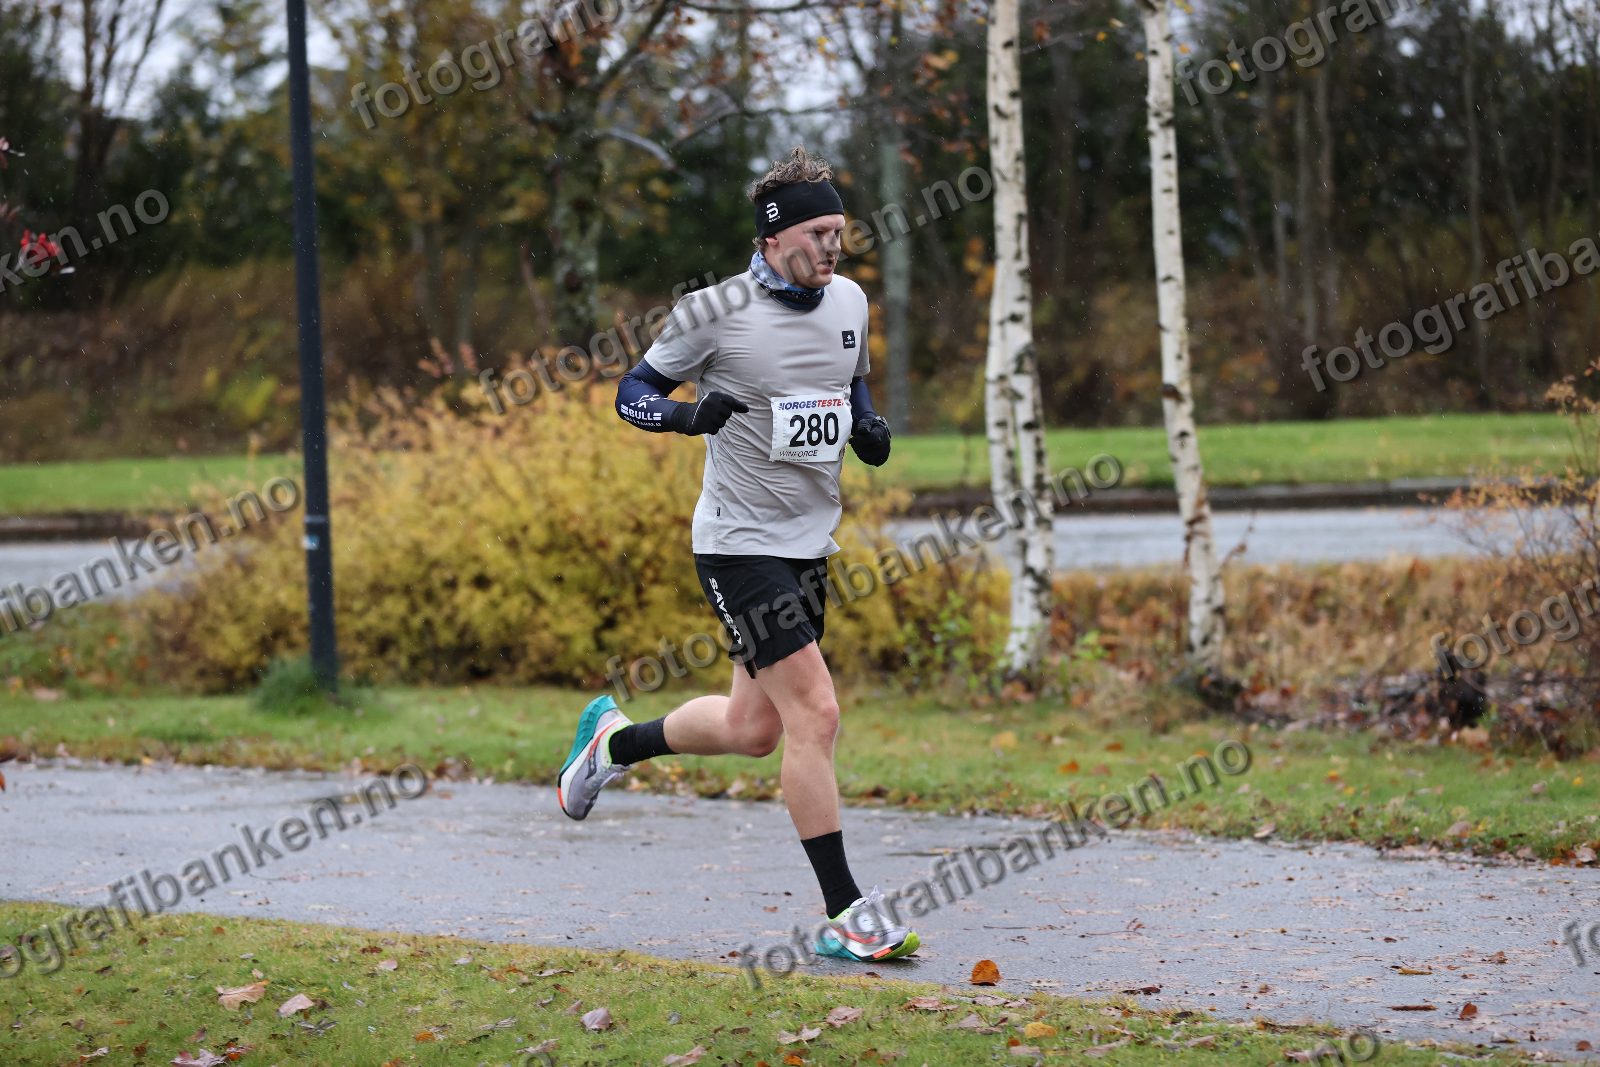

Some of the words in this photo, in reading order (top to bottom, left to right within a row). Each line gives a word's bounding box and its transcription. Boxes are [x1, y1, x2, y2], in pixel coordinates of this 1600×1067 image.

[778, 398, 845, 410] NORGESTESTE
[789, 412, 839, 447] 280
[708, 577, 742, 645] SAYSKY
